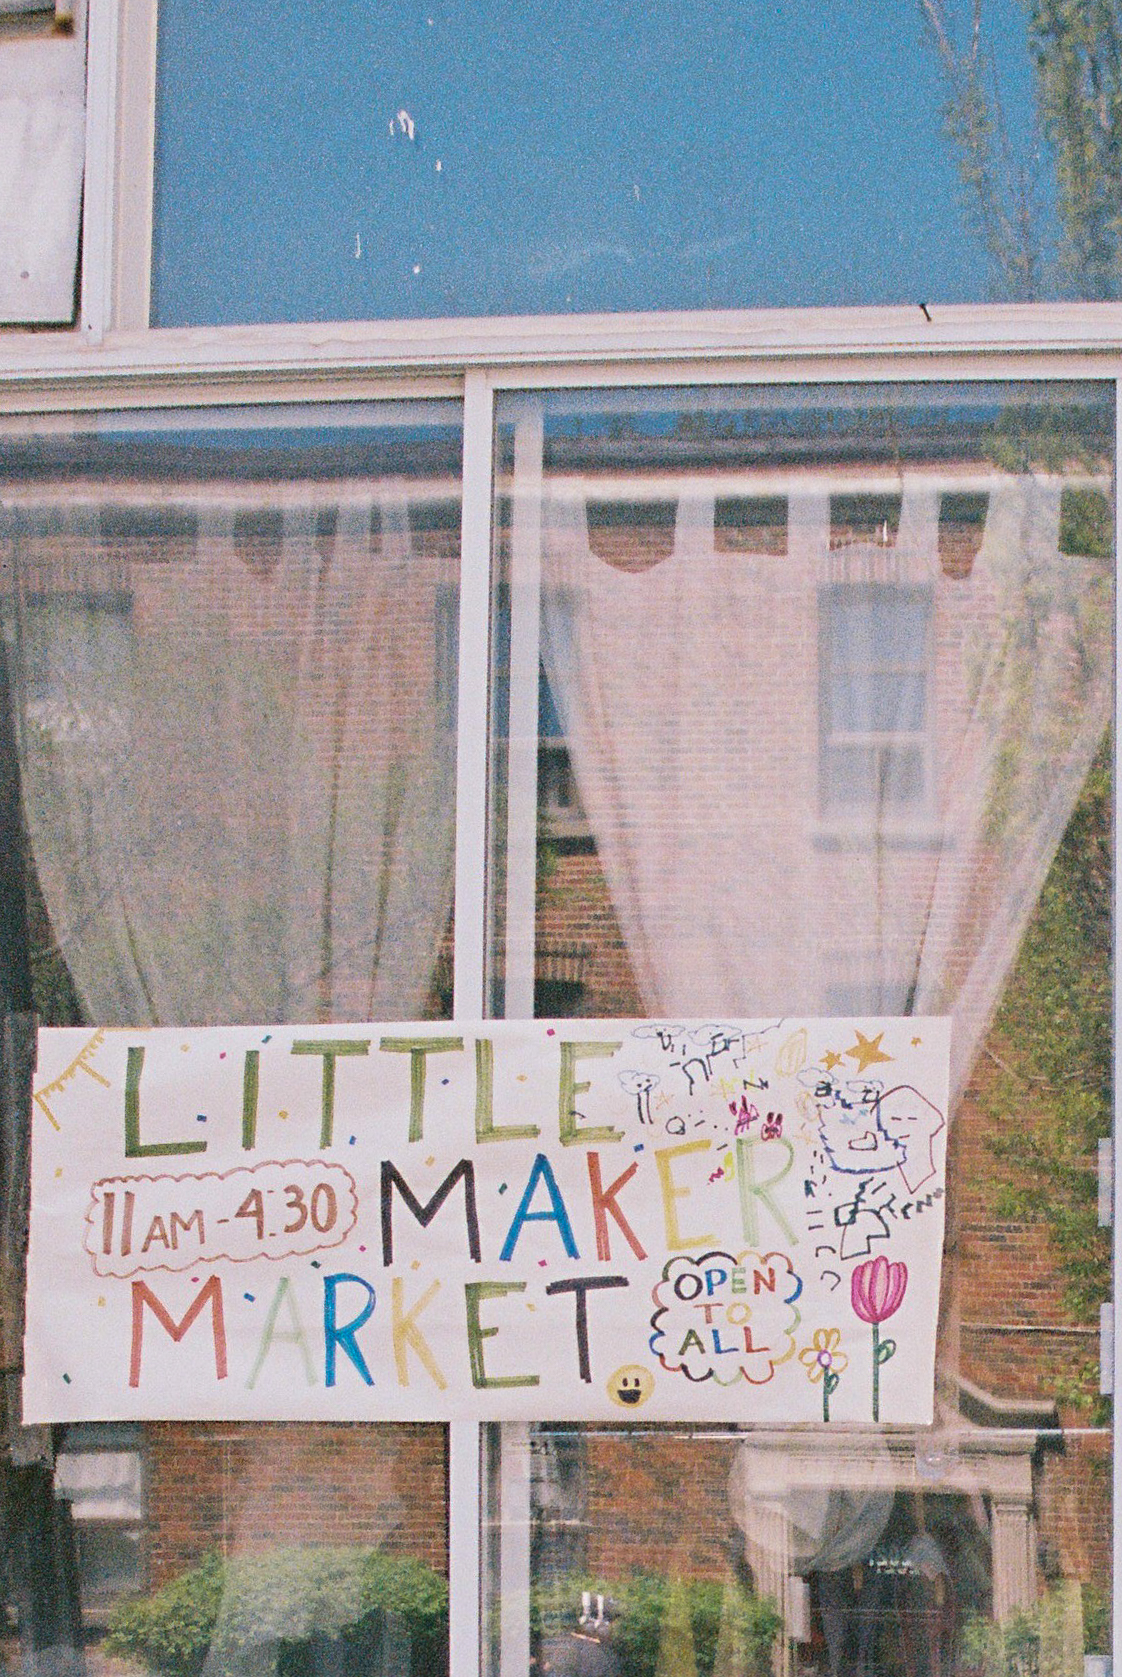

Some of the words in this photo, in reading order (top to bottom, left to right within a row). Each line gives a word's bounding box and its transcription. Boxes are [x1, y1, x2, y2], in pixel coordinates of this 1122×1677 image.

[124, 1037, 624, 1158] LITTLE
[380, 1138, 799, 1267] MAKER
[673, 1266, 776, 1301] OPEN
[693, 1302, 752, 1325] TO
[128, 1271, 630, 1390] MARKET
[678, 1326, 771, 1356] ALL
